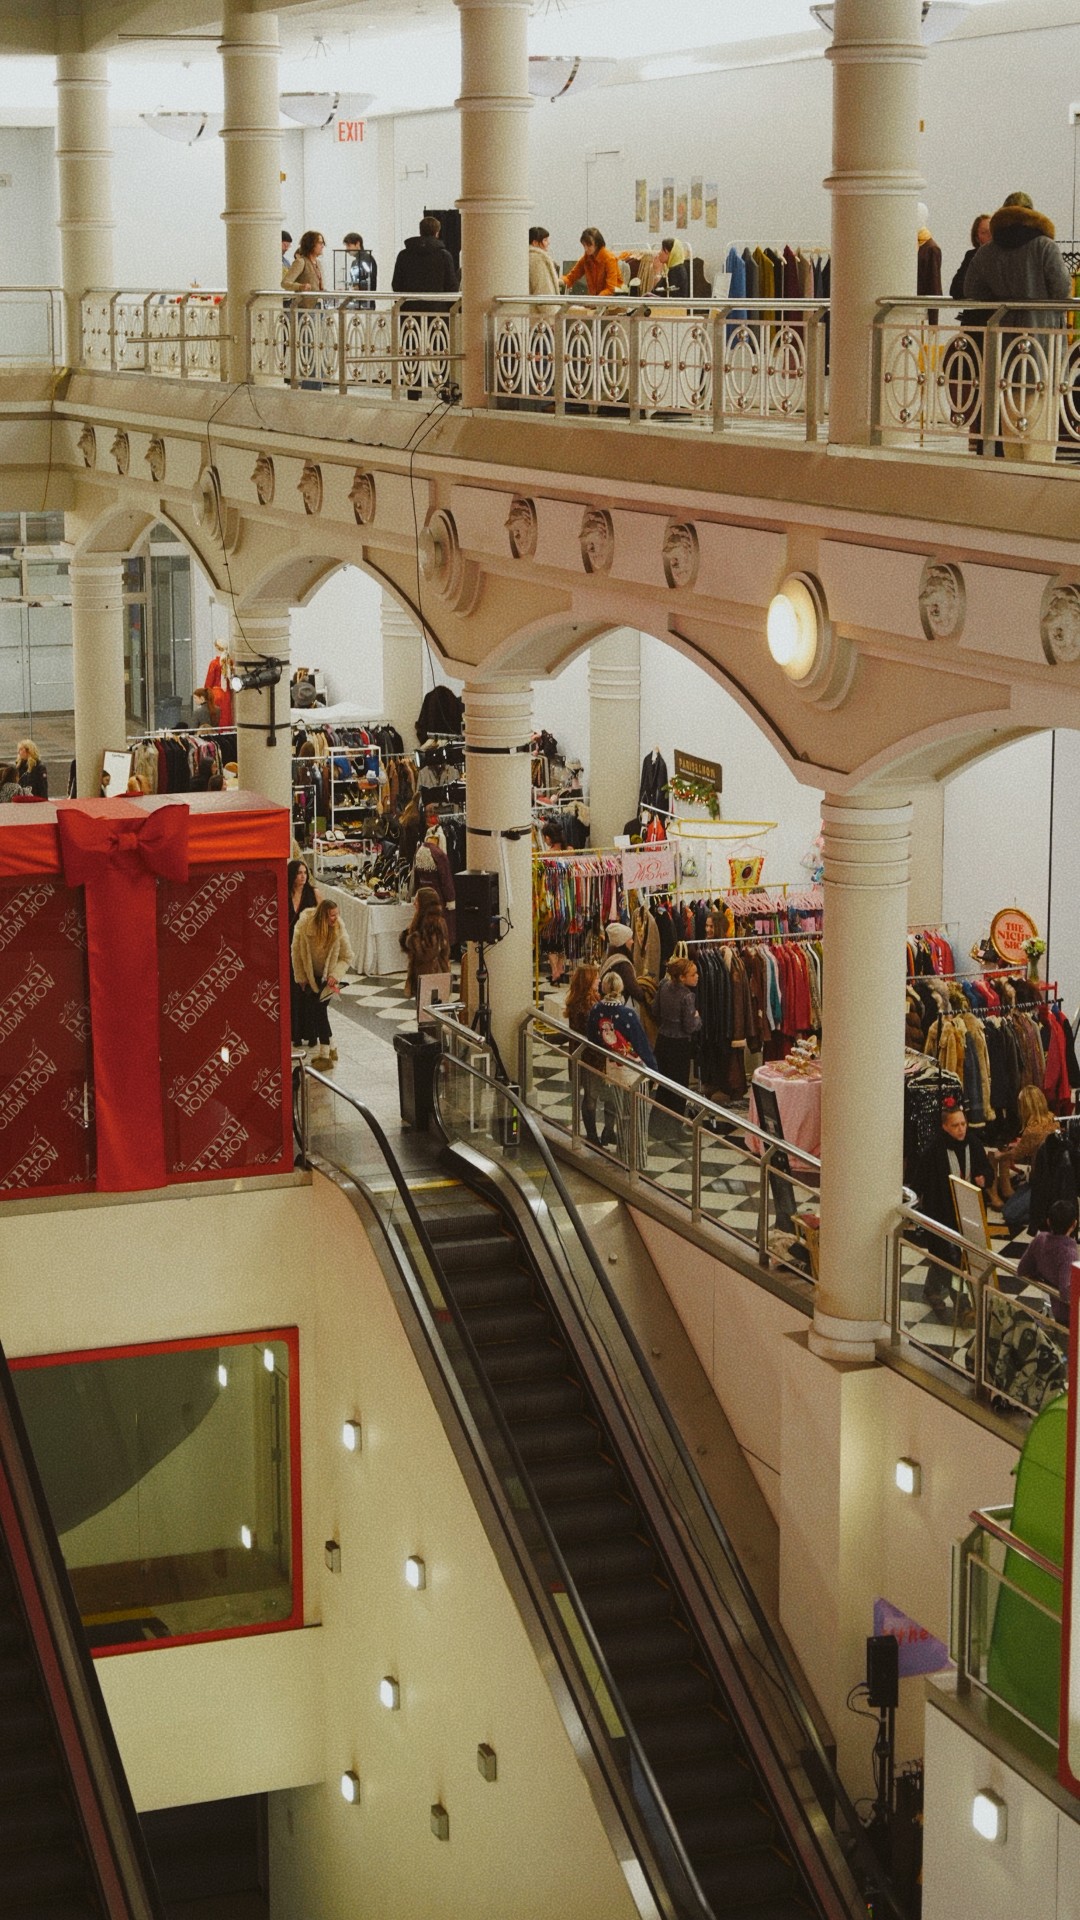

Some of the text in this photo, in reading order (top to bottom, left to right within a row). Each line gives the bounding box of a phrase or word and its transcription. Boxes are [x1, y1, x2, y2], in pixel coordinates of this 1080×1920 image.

[338, 121, 364, 141] EXIT
[24, 883, 55, 918] SHOW
[178, 871, 246, 944] HOLIDAY SHOW
[1003, 940, 1022, 951] SHO
[1005, 922, 1024, 933] THE
[24, 973, 55, 1010] SHOW
[169, 947, 237, 1023] normal
[178, 957, 246, 1034] HOLIDAY SHOW
[0, 1059, 57, 1130] OLIDAY SHOW
[182, 1041, 250, 1117] HOLIDAY SHOW
[219, 1127, 250, 1162] SHOW
[28, 1146, 58, 1182] SHOW
